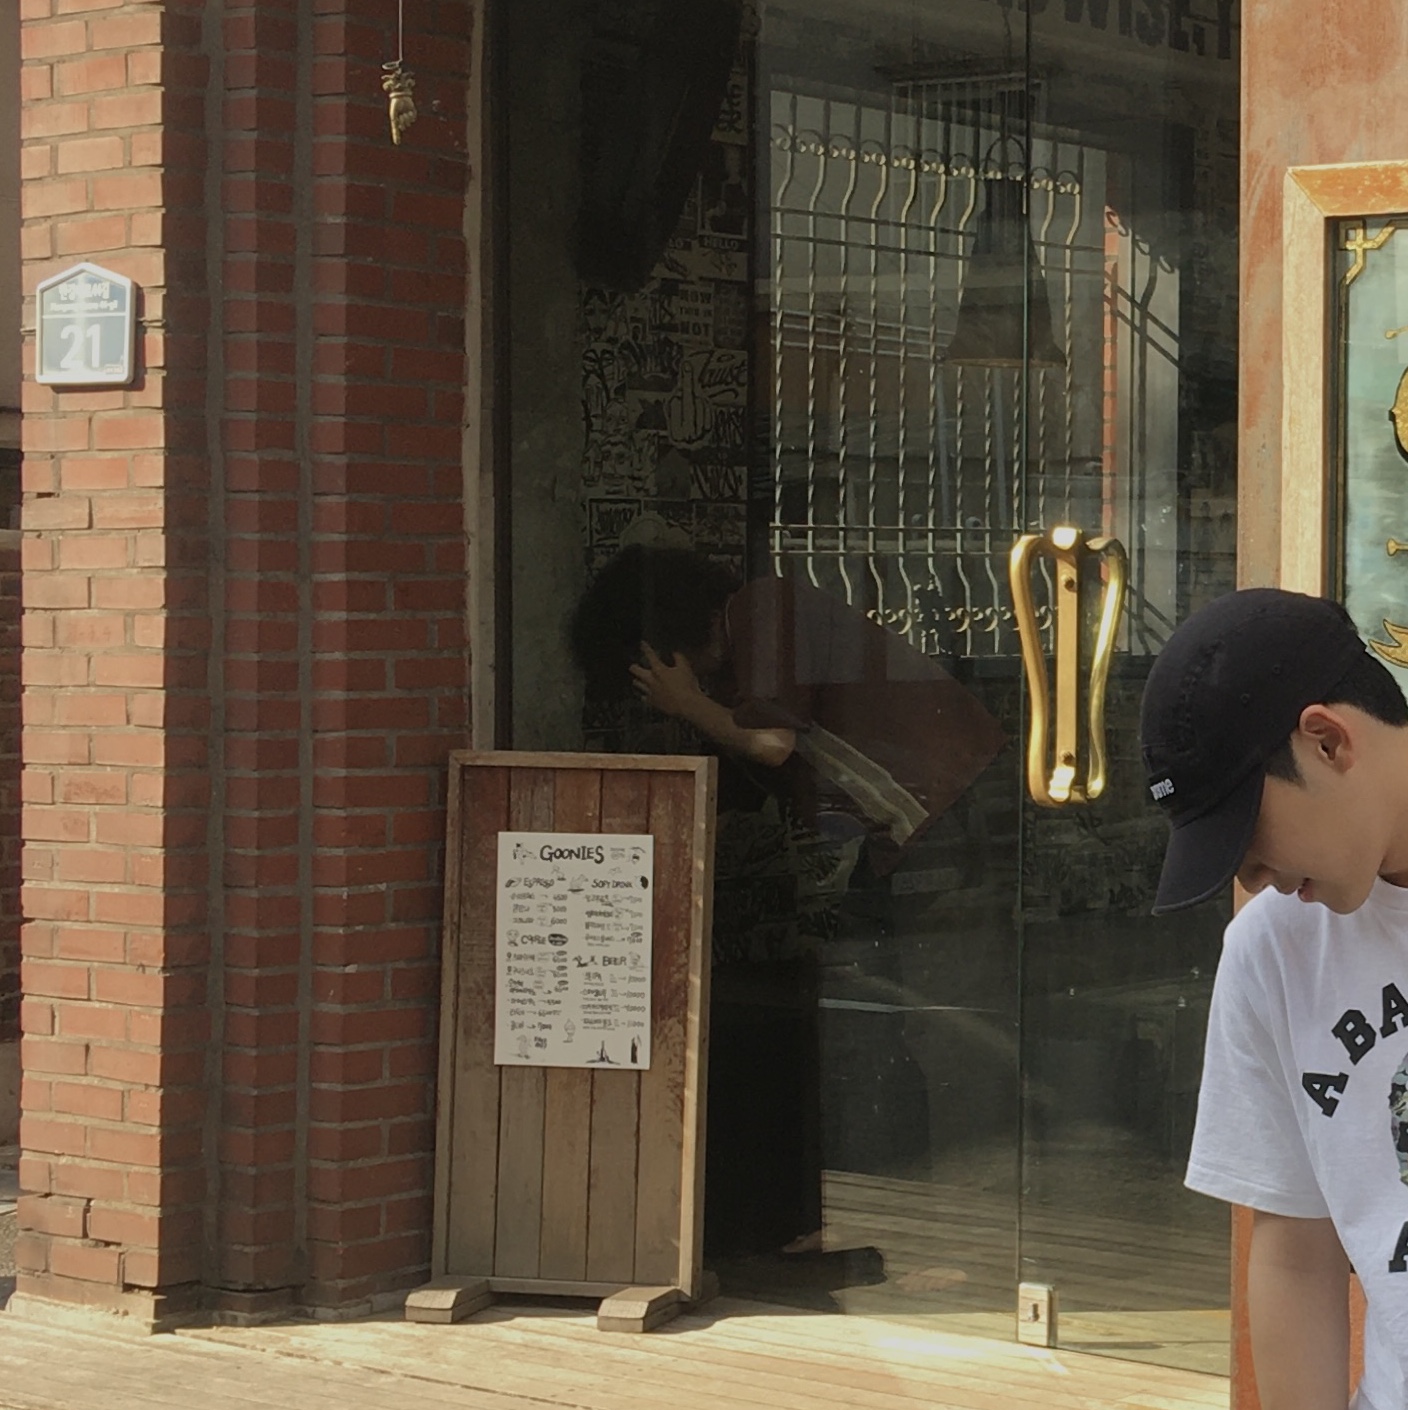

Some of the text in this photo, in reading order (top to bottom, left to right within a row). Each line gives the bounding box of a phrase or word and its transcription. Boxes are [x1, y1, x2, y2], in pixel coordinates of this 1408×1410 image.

[60, 324, 101, 369] 21
[539, 844, 605, 865] GOONIES
[602, 955, 627, 967] BEER
[1302, 1072, 1349, 1118] A
